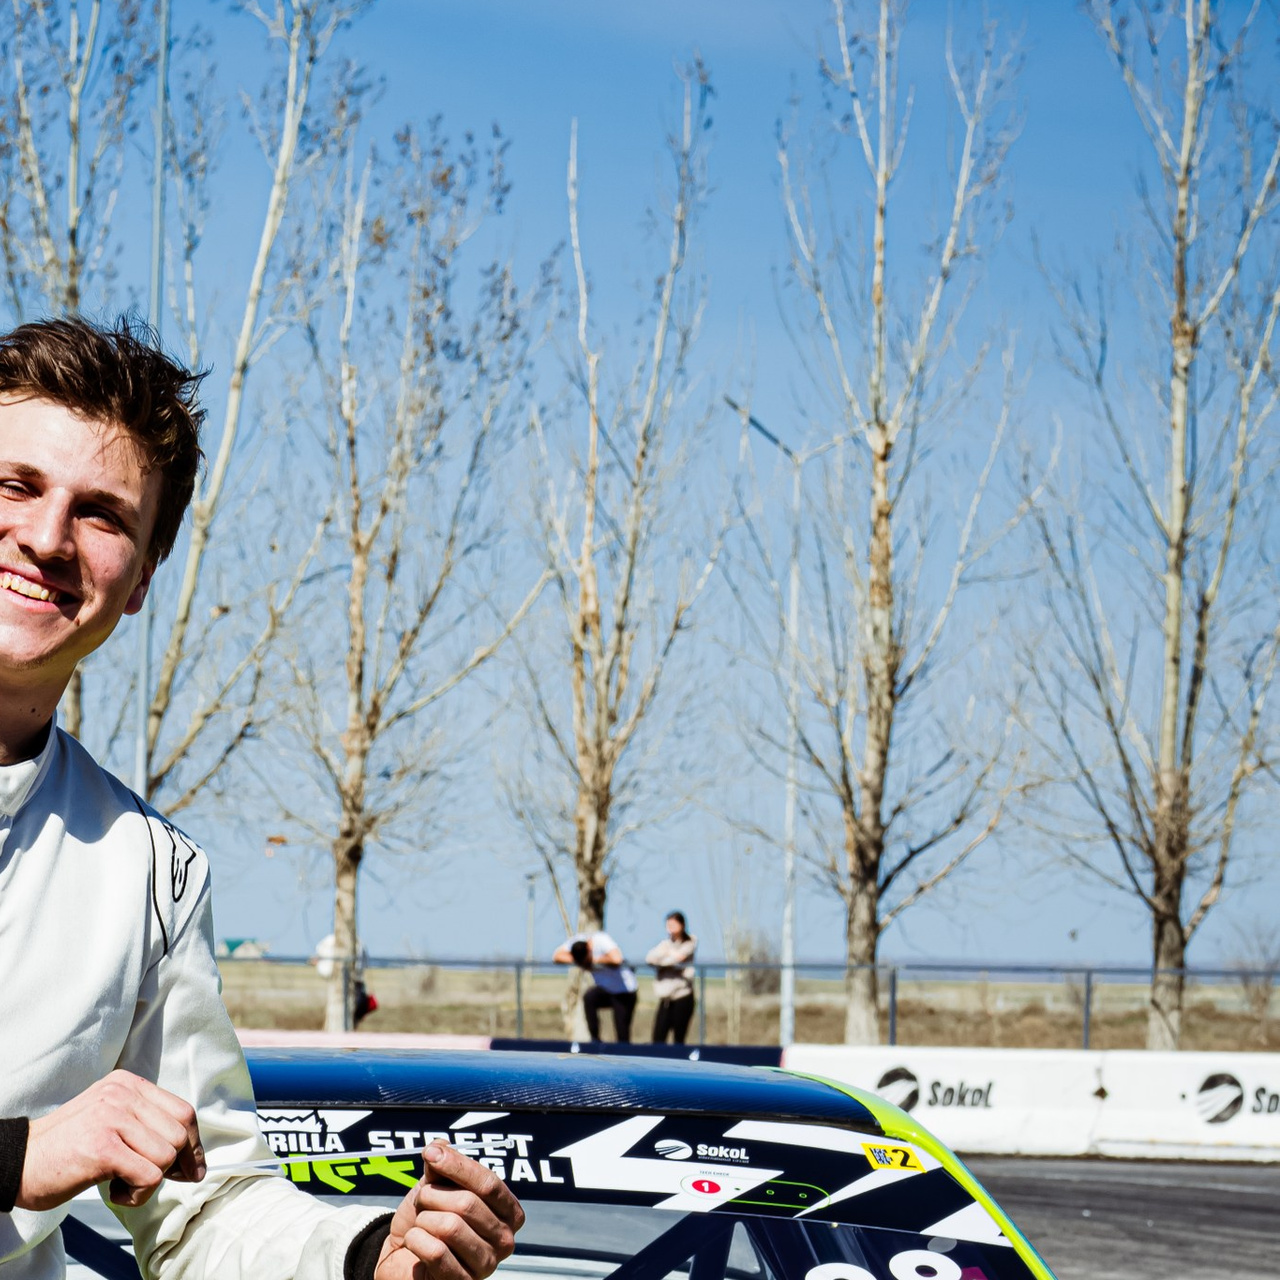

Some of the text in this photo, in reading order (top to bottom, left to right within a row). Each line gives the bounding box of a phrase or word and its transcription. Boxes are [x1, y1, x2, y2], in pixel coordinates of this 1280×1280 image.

[262, 1132, 346, 1152] RILLA
[470, 1157, 565, 1184] GAL
[701, 1181, 710, 1192] 1
